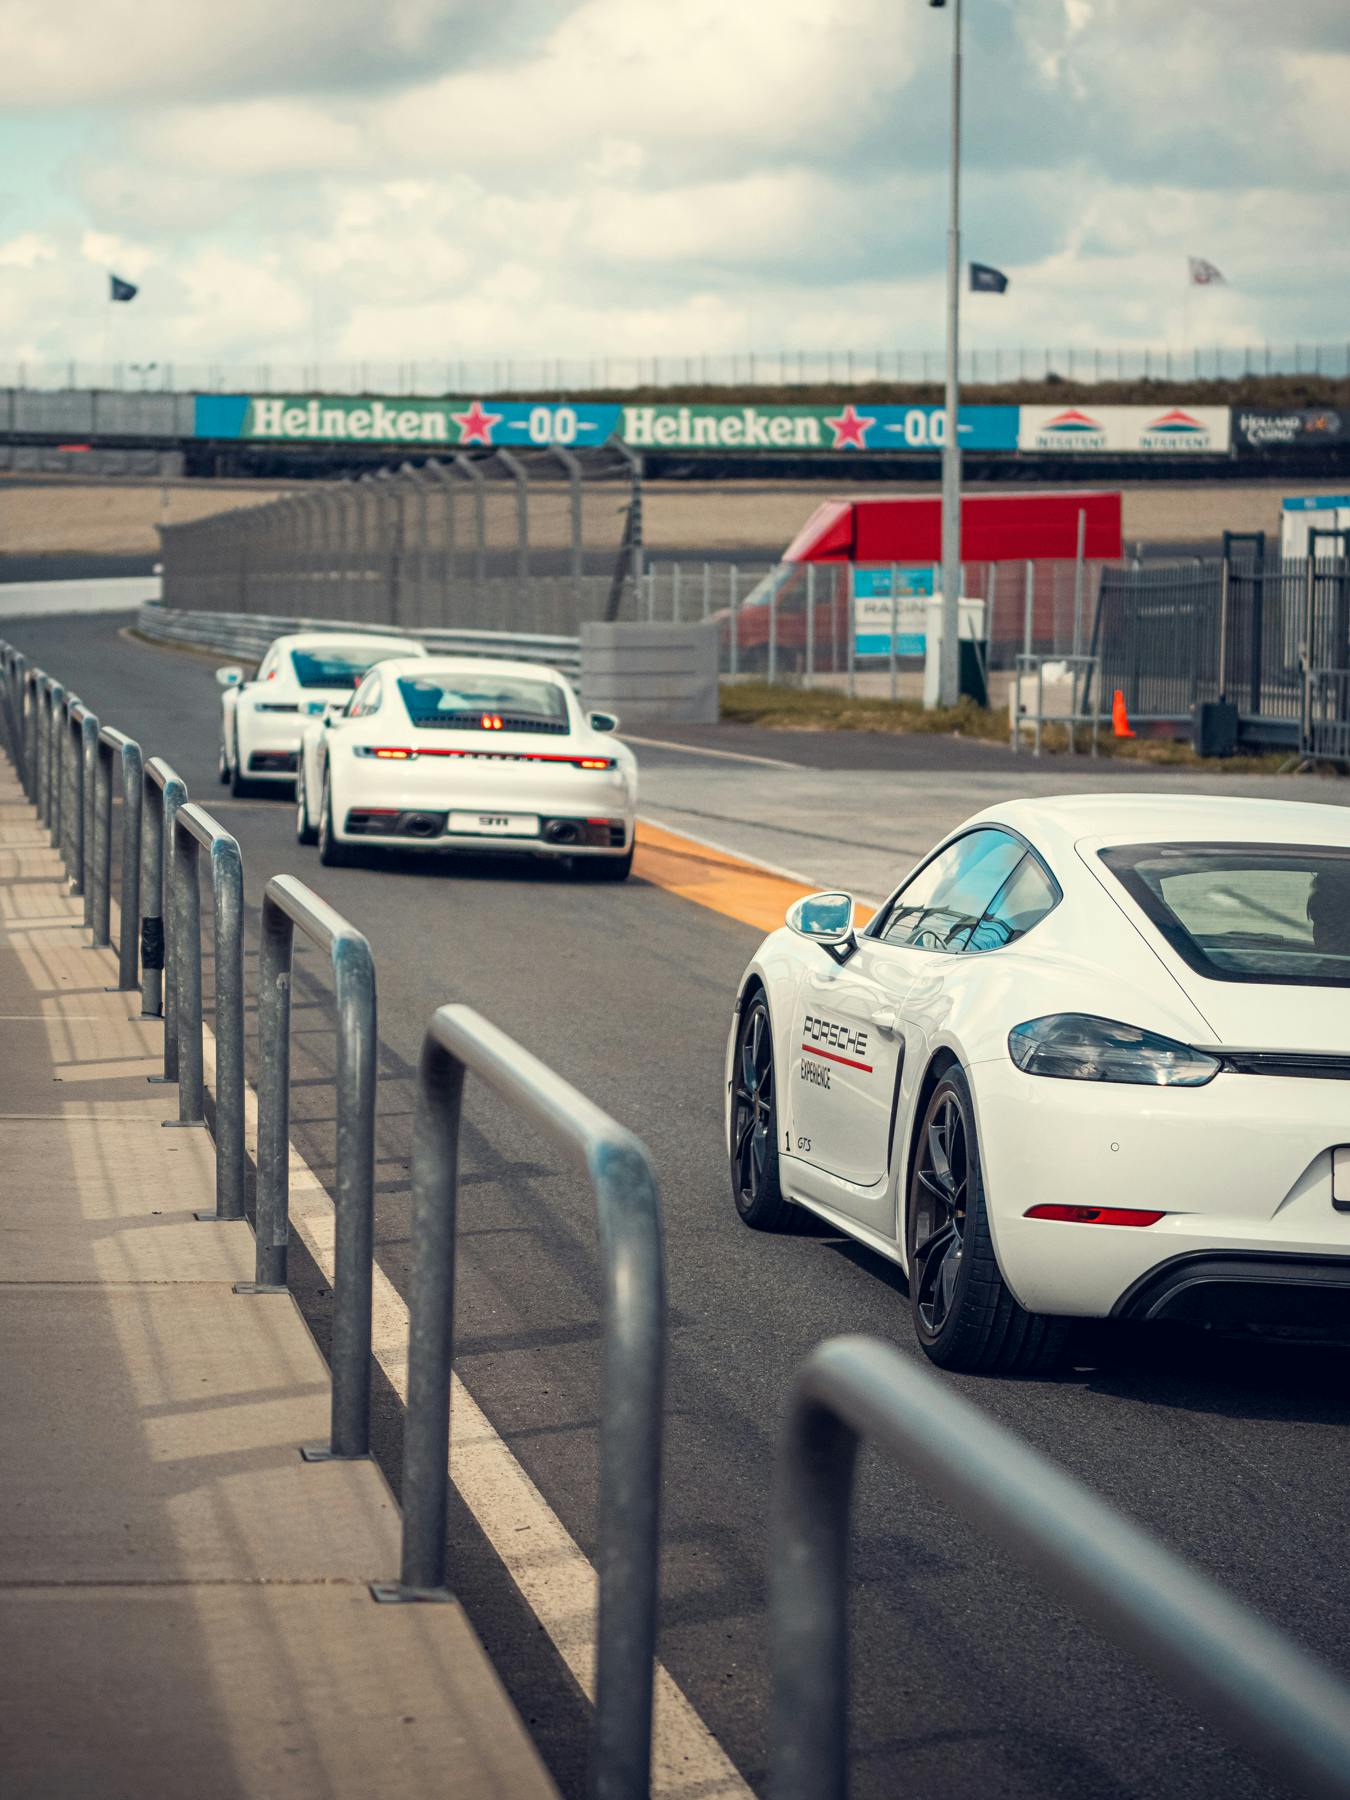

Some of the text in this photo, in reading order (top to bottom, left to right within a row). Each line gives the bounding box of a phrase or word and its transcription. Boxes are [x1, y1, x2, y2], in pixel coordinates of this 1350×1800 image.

[250, 399, 448, 441] Heineken
[623, 407, 821, 447] Heineken
[803, 1015, 868, 1055] PORSCHE
[800, 1058, 831, 1090] EXPERIENCE
[797, 1137, 811, 1152] GTS
